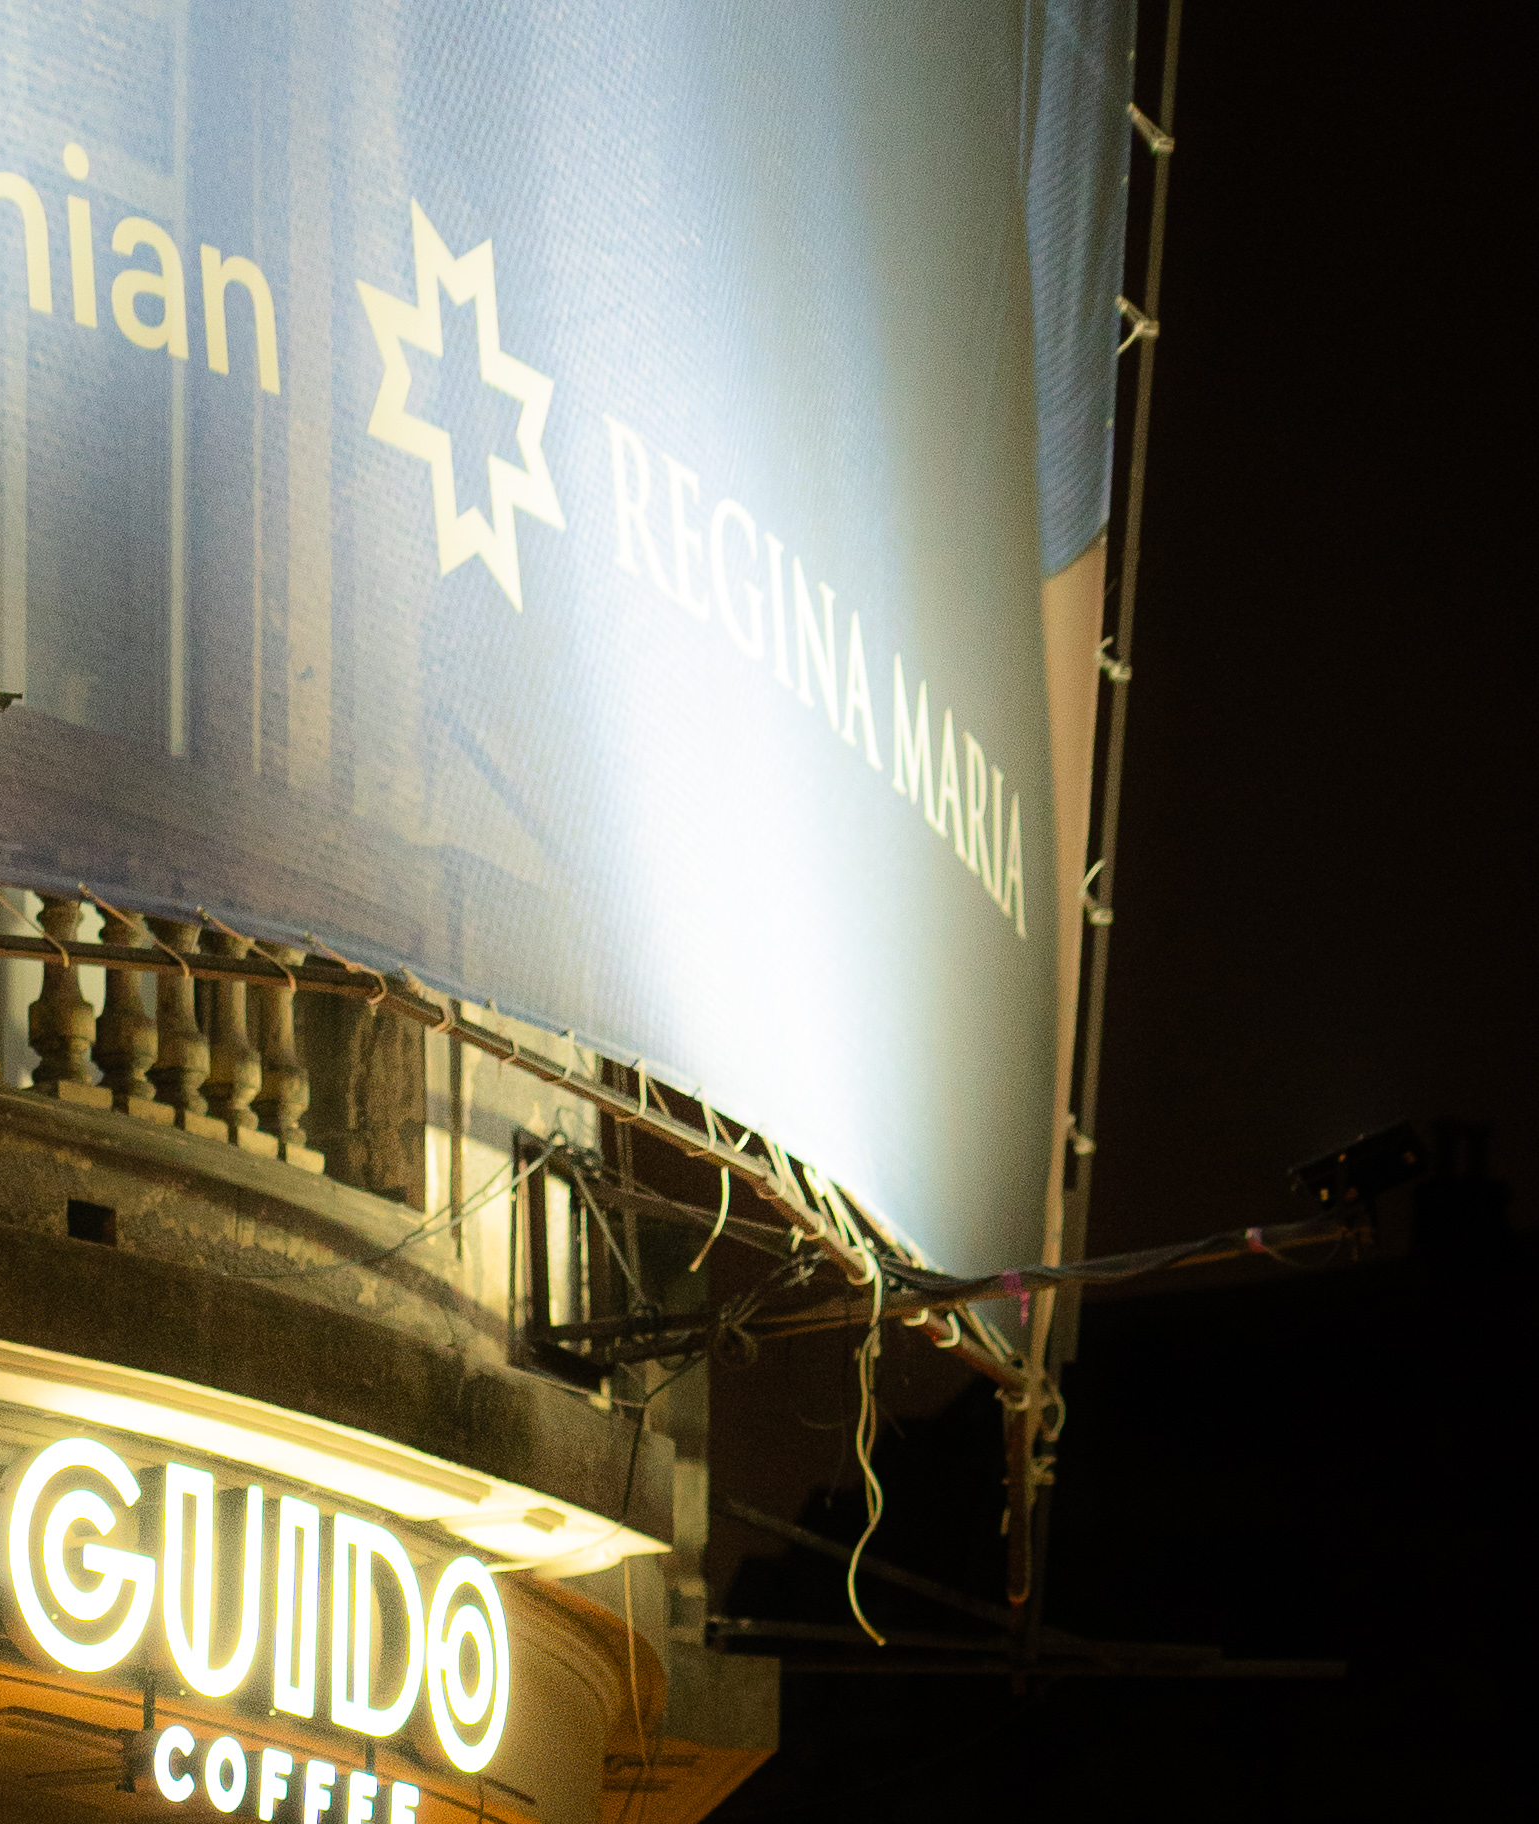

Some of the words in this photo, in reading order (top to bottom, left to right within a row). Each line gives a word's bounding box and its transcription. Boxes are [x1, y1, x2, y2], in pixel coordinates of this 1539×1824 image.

[602, 413, 884, 772] REGINA
[892, 652, 1028, 938] MARIA
[9, 1437, 512, 1774] GUIDO
